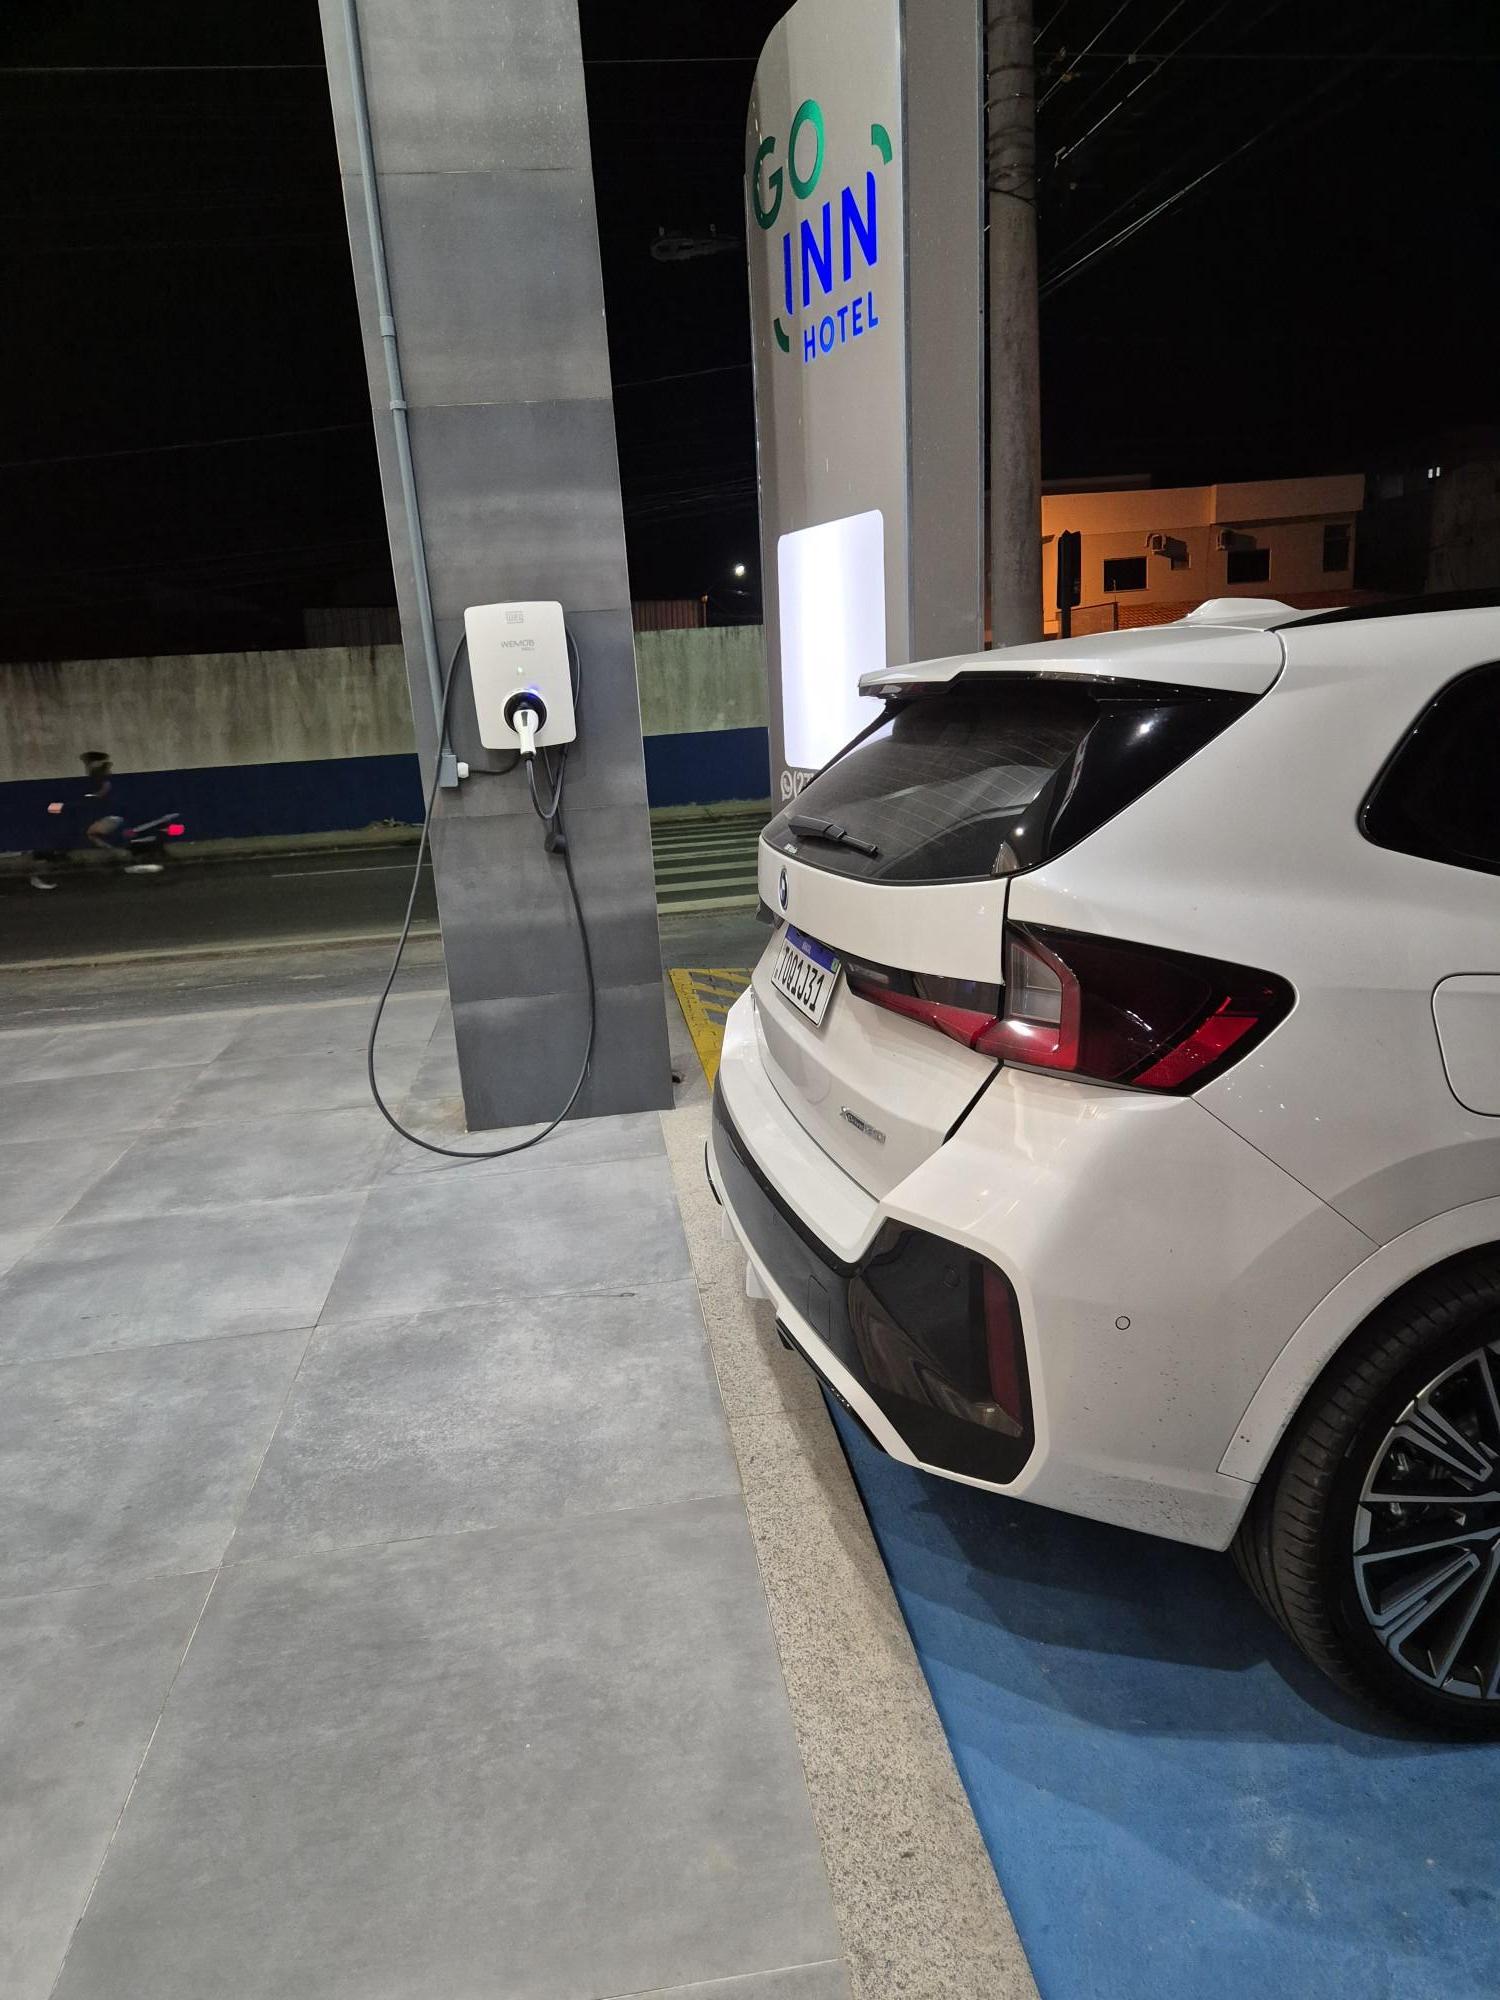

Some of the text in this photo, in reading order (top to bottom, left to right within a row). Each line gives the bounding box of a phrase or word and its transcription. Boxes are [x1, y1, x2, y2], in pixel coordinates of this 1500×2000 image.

[753, 98, 825, 230] GO
[783, 170, 878, 316] INN
[803, 290, 879, 363] HOTEL
